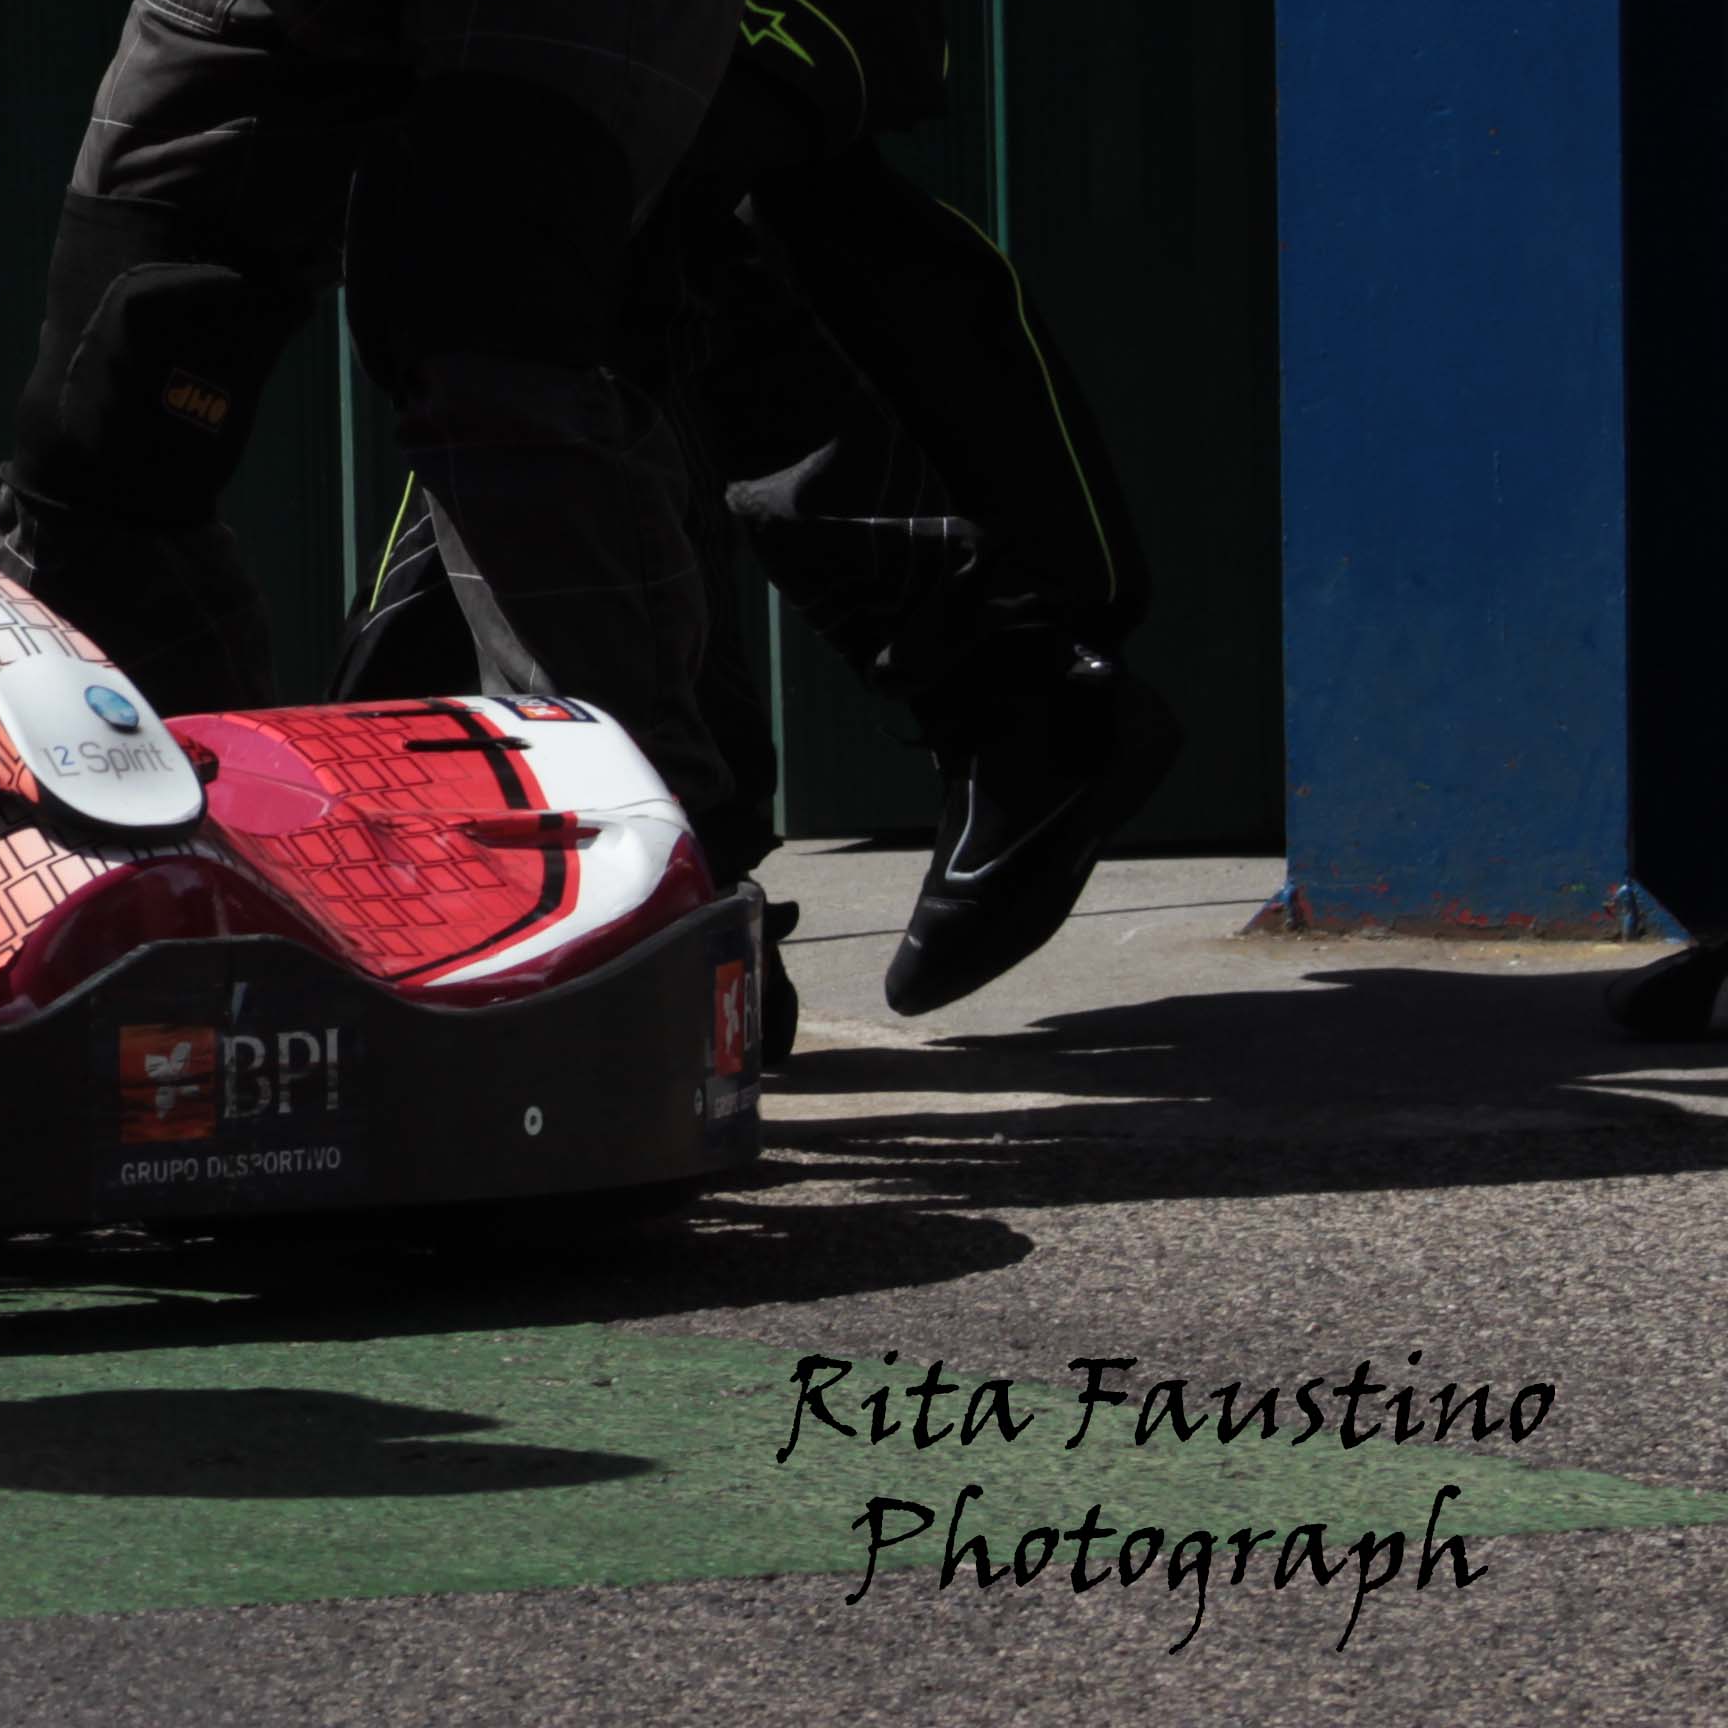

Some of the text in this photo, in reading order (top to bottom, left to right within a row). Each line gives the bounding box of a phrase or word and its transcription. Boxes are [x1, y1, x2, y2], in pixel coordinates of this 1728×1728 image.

[78, 740, 174, 782] Spirit
[222, 1027, 341, 1120] BPI
[120, 1157, 200, 1186] GRUPO
